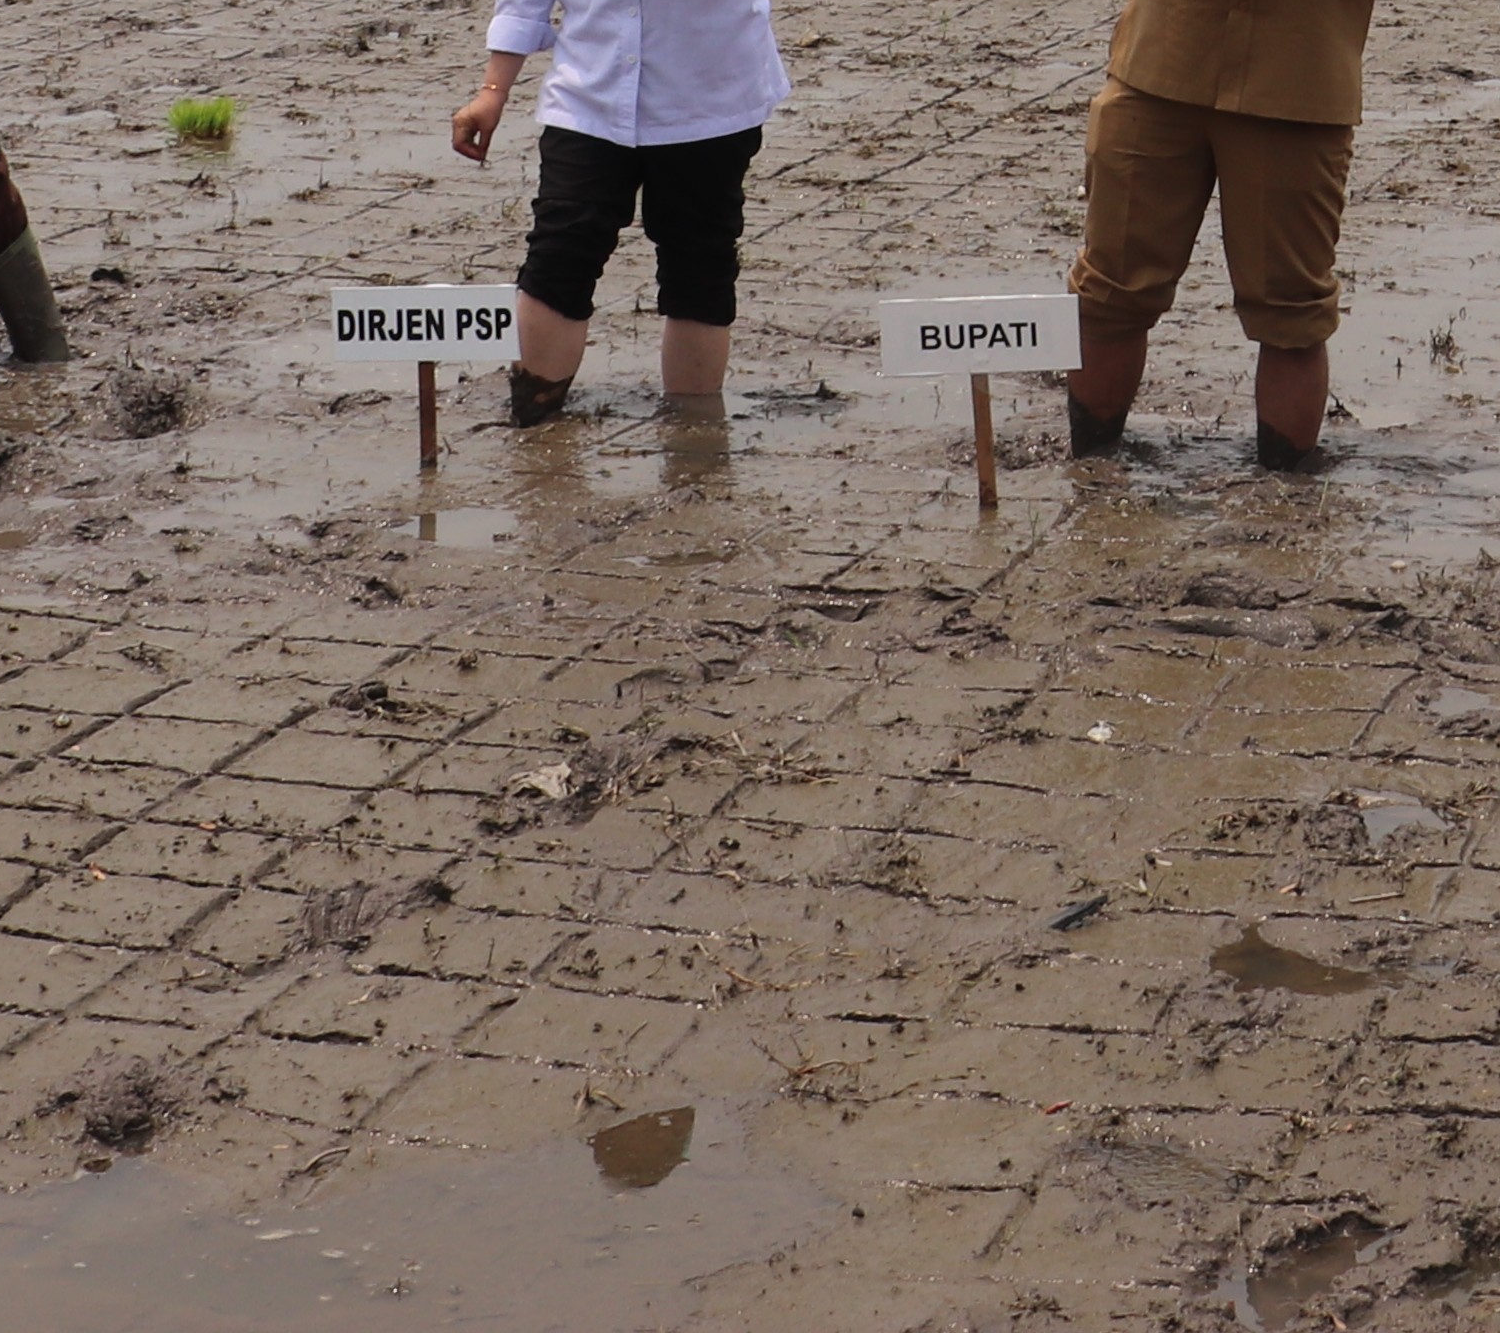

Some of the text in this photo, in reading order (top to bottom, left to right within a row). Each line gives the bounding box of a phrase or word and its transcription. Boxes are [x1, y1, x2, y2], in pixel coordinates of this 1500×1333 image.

[337, 307, 513, 342] DIRJEN PSP
[920, 321, 1038, 351] BUPATI
